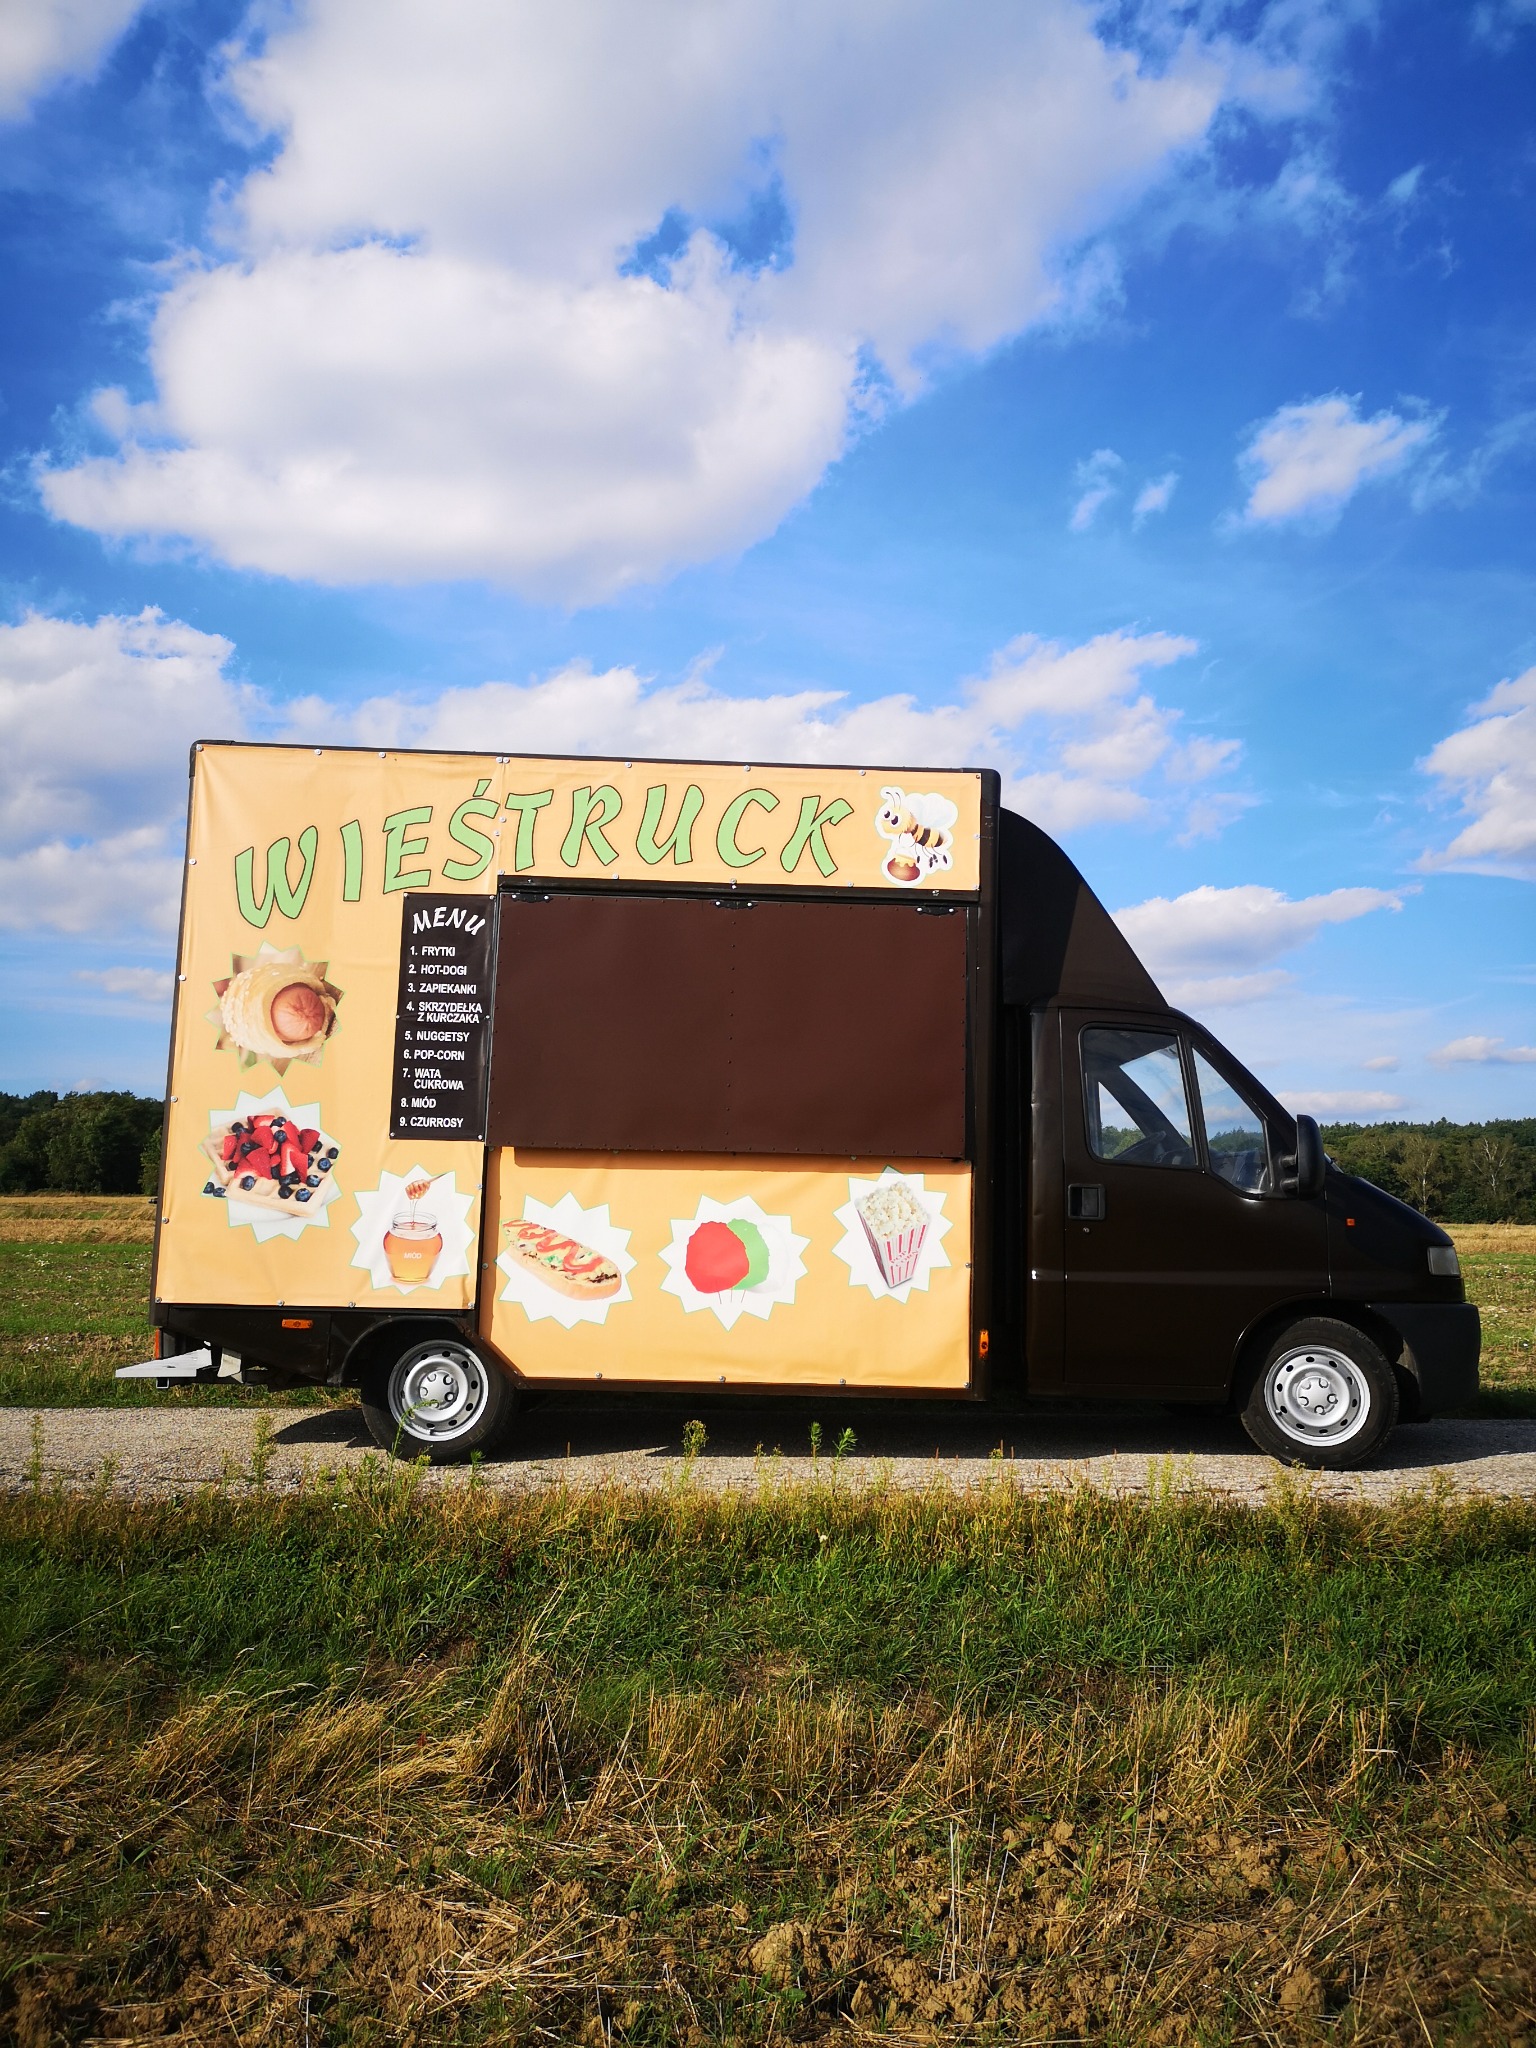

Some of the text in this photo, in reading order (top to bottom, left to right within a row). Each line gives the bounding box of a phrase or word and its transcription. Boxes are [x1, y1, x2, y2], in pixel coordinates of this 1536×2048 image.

[234, 779, 855, 929] WIEŚTRUCK
[412, 906, 486, 936] MENU
[409, 945, 456, 957] 1. FRYTKI
[408, 963, 468, 976] 2. HOT-DOGI
[407, 982, 477, 995] 3. ZAPIEKANKI
[406, 1001, 483, 1013] 4. SKRZYDEŁKA
[417, 1012, 480, 1024] Z KURCZAKA
[404, 1030, 470, 1042] 5. NUGGETSY
[403, 1049, 465, 1061] 6. POP-CORN
[402, 1068, 442, 1079] 7. WATA
[413, 1079, 465, 1090] CUKROWA
[400, 1096, 437, 1109] 8. MIÓD
[399, 1116, 464, 1128] 9. CZURROSY
